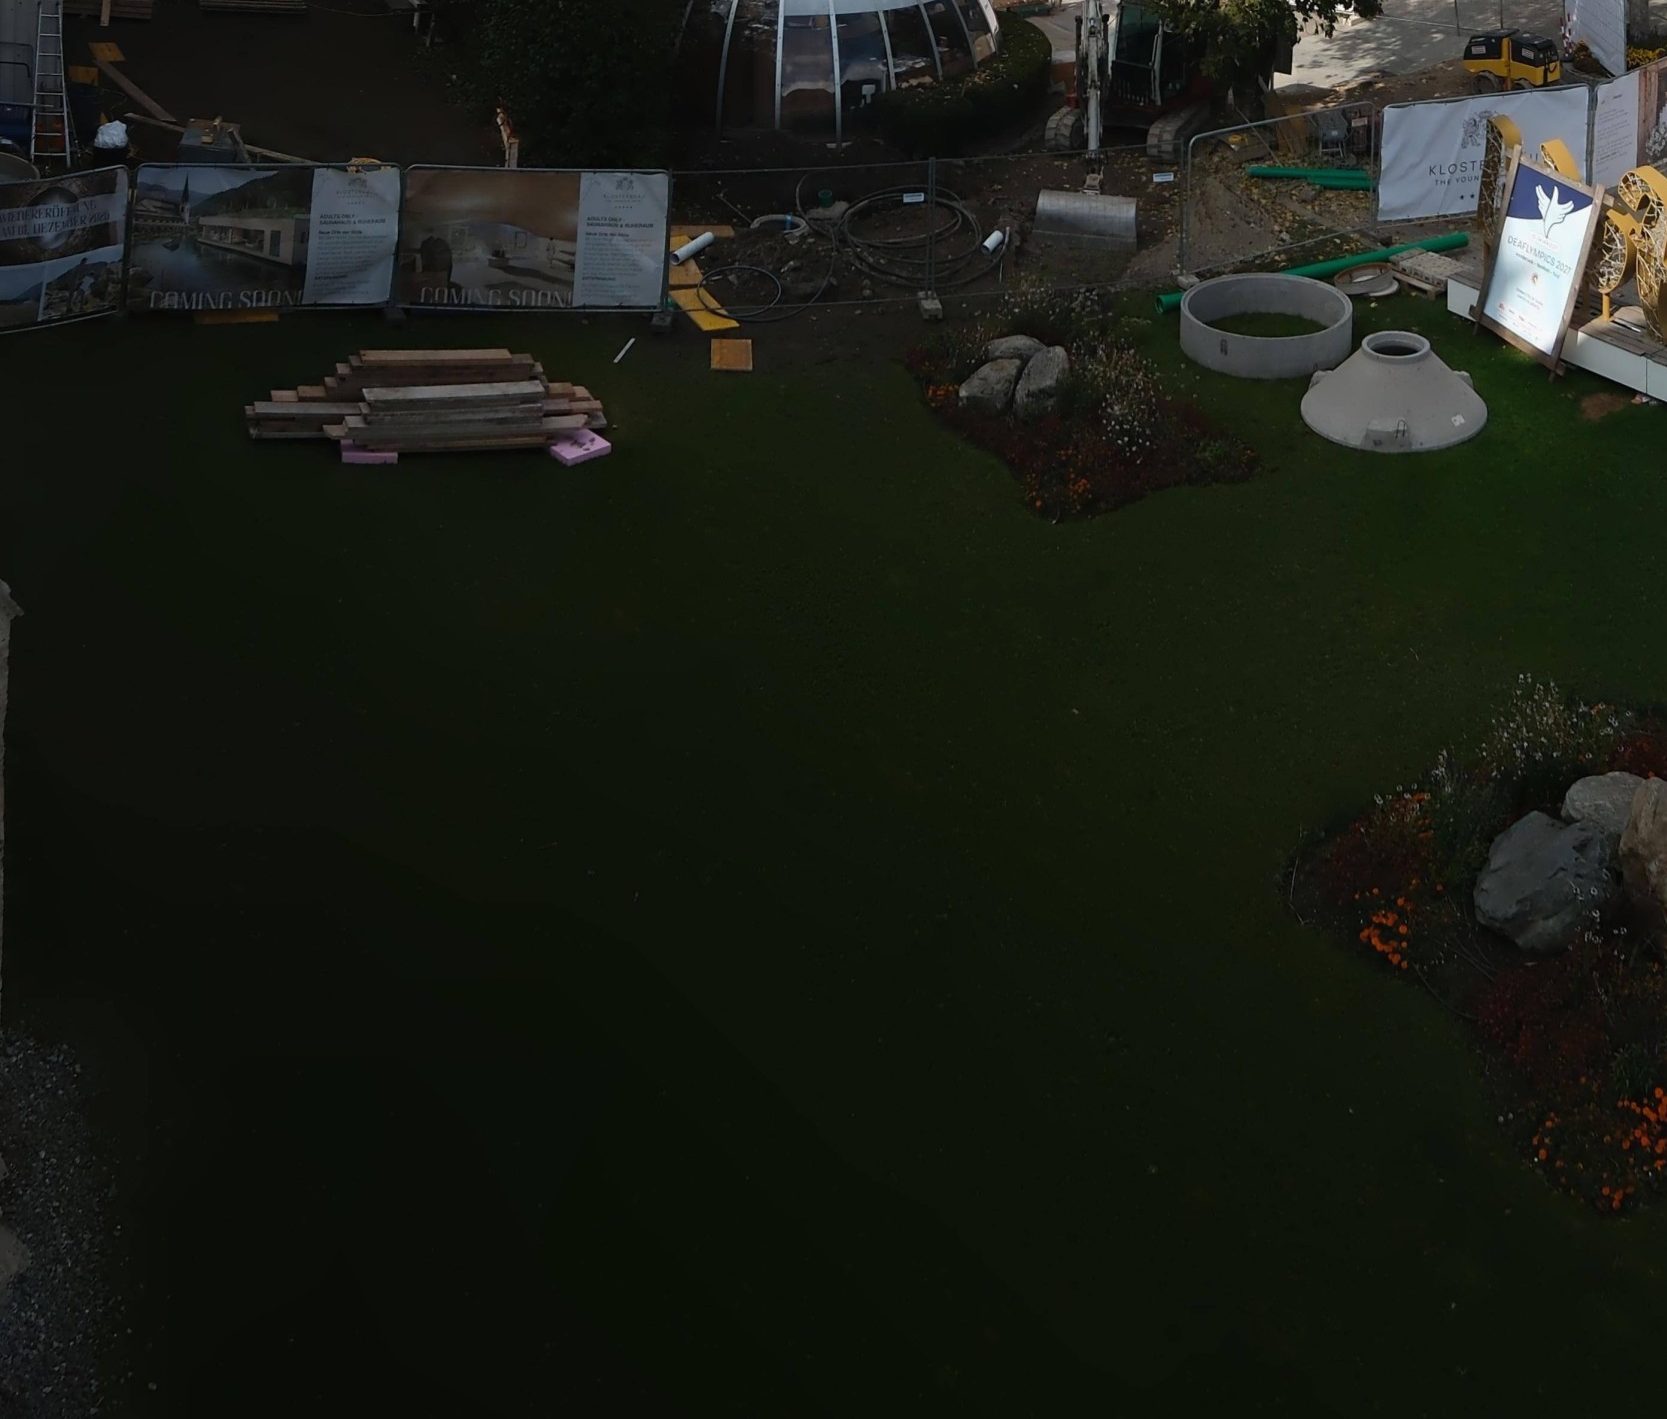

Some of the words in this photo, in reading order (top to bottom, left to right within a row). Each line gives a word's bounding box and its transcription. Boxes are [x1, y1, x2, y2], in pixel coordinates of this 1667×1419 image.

[1455, 175, 1479, 184] YOUN
[1507, 235, 1556, 267] DEAFLYMPICS
[1556, 260, 1572, 275] 2027
[150, 290, 233, 309] COMING
[420, 286, 502, 305] COMING
